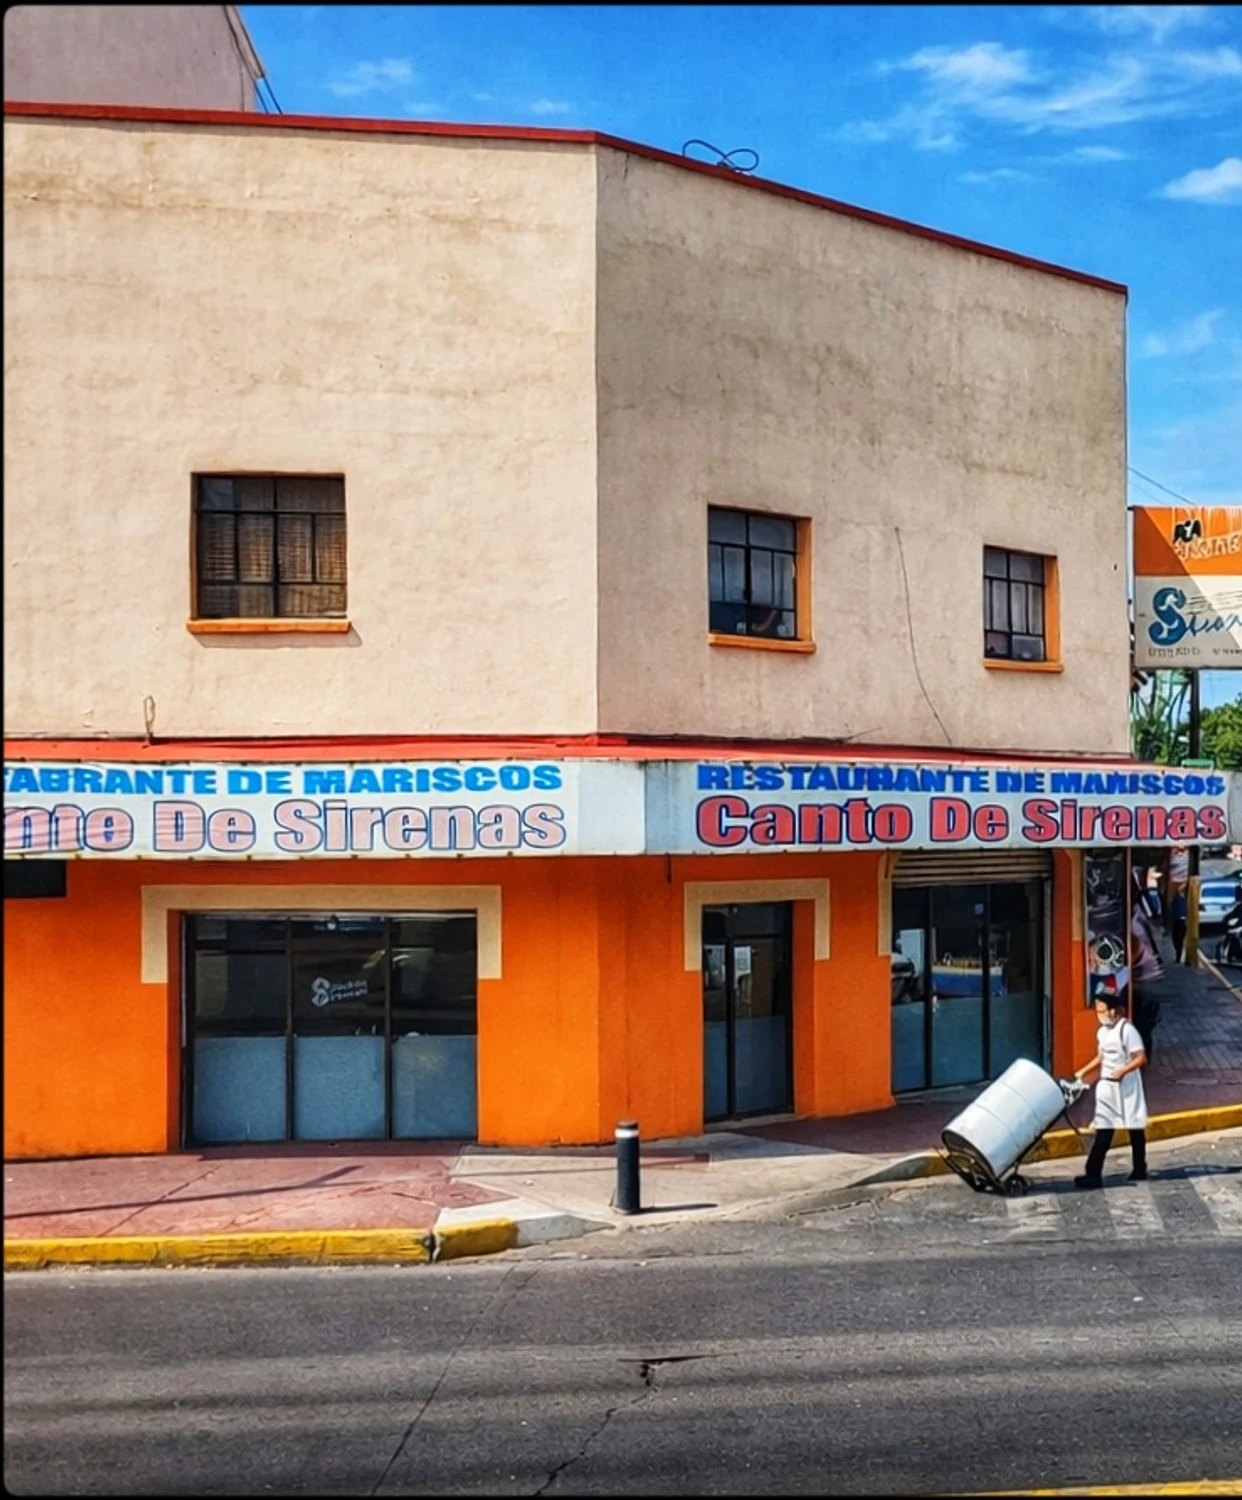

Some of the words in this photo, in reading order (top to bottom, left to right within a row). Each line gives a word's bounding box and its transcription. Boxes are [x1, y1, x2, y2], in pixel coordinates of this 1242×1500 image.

[228, 769, 292, 795] DE
[304, 765, 562, 794] MARISCOS
[697, 764, 989, 793] RESTAURANTE
[996, 771, 1044, 793] DE
[1051, 772, 1225, 796] MARISCOS
[153, 800, 256, 852] De
[274, 799, 566, 852] Sirenas
[697, 795, 912, 847] Canto
[930, 796, 1009, 842] De
[1022, 798, 1227, 843] Sirenas
